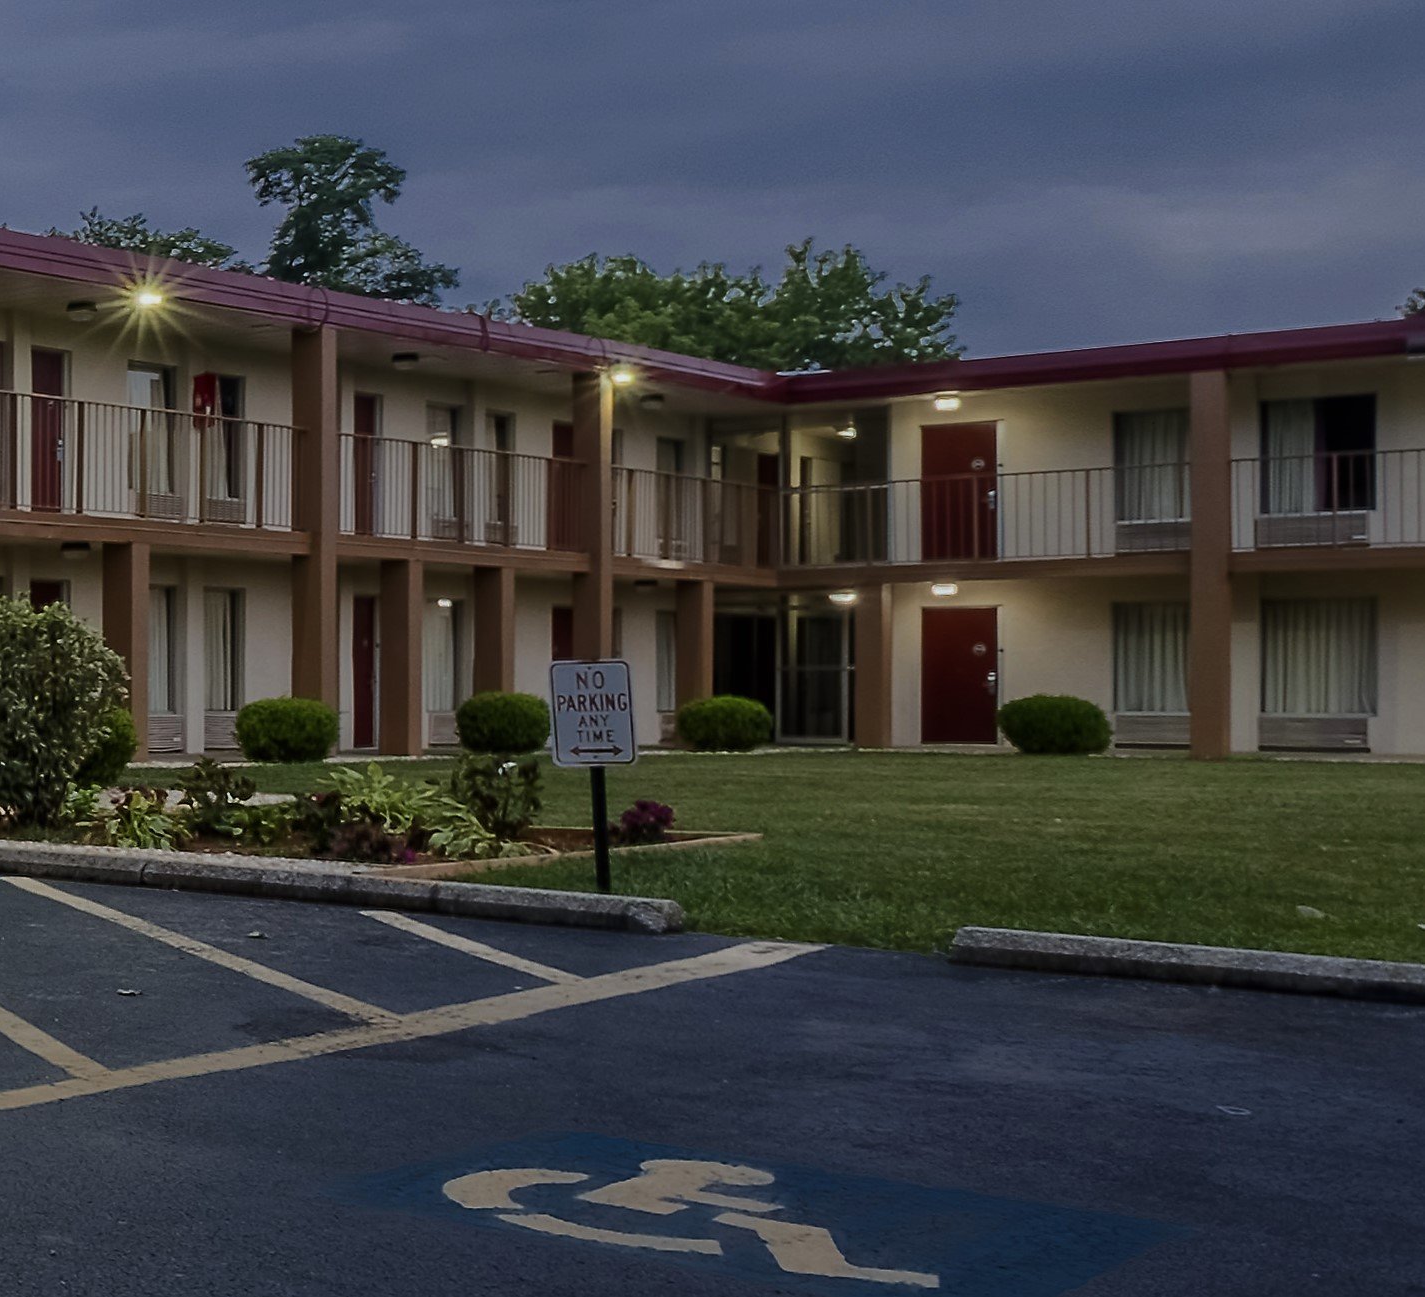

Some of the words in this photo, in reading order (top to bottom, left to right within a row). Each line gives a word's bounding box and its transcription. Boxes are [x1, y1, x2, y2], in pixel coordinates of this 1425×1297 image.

[576, 671, 605, 690] NO
[557, 693, 628, 712] PARKING
[578, 715, 609, 727] ANY
[577, 730, 615, 743] TIME
